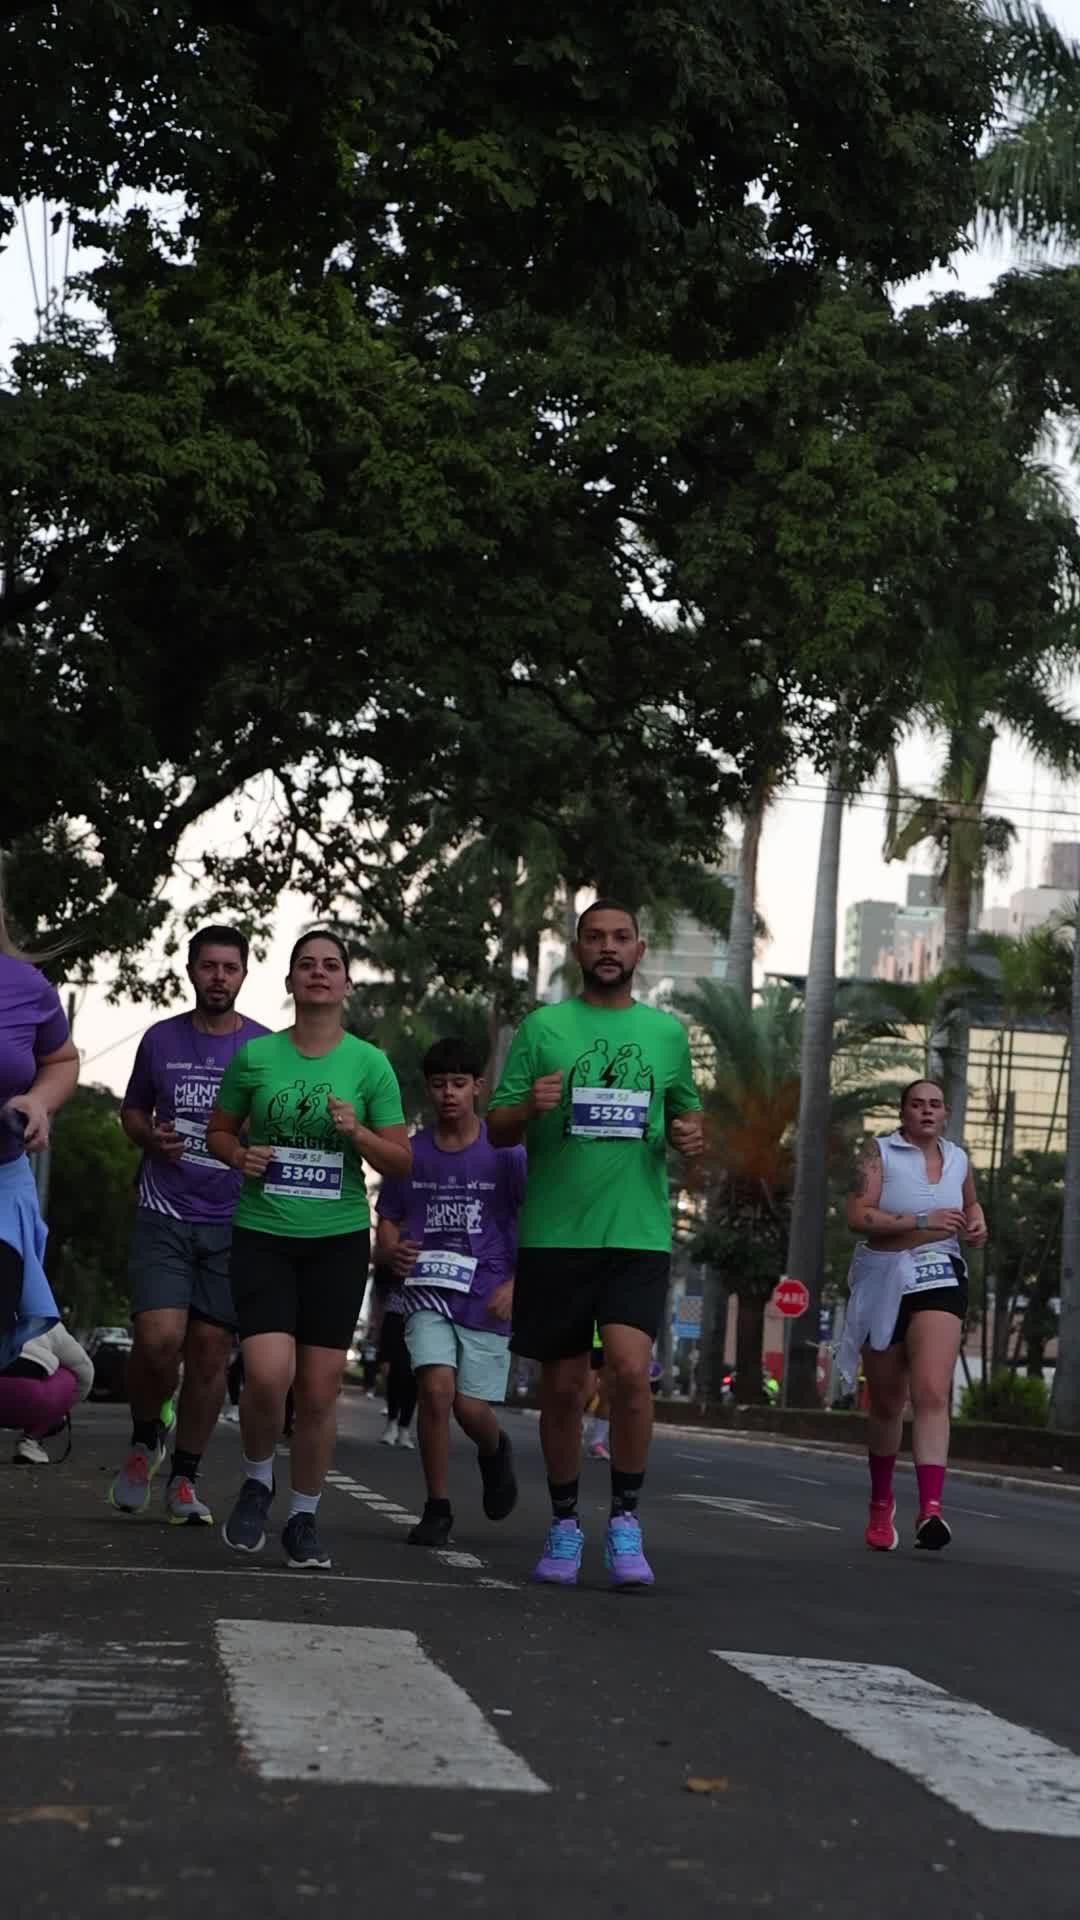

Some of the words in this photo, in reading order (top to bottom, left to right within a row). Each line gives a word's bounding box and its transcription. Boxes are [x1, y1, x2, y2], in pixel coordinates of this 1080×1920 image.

[175, 1083, 221, 1097] MUND
[175, 1095, 215, 1107] MELH
[589, 1106, 635, 1120] 5526
[281, 1165, 326, 1182] 5340
[421, 1263, 459, 1276] 5955
